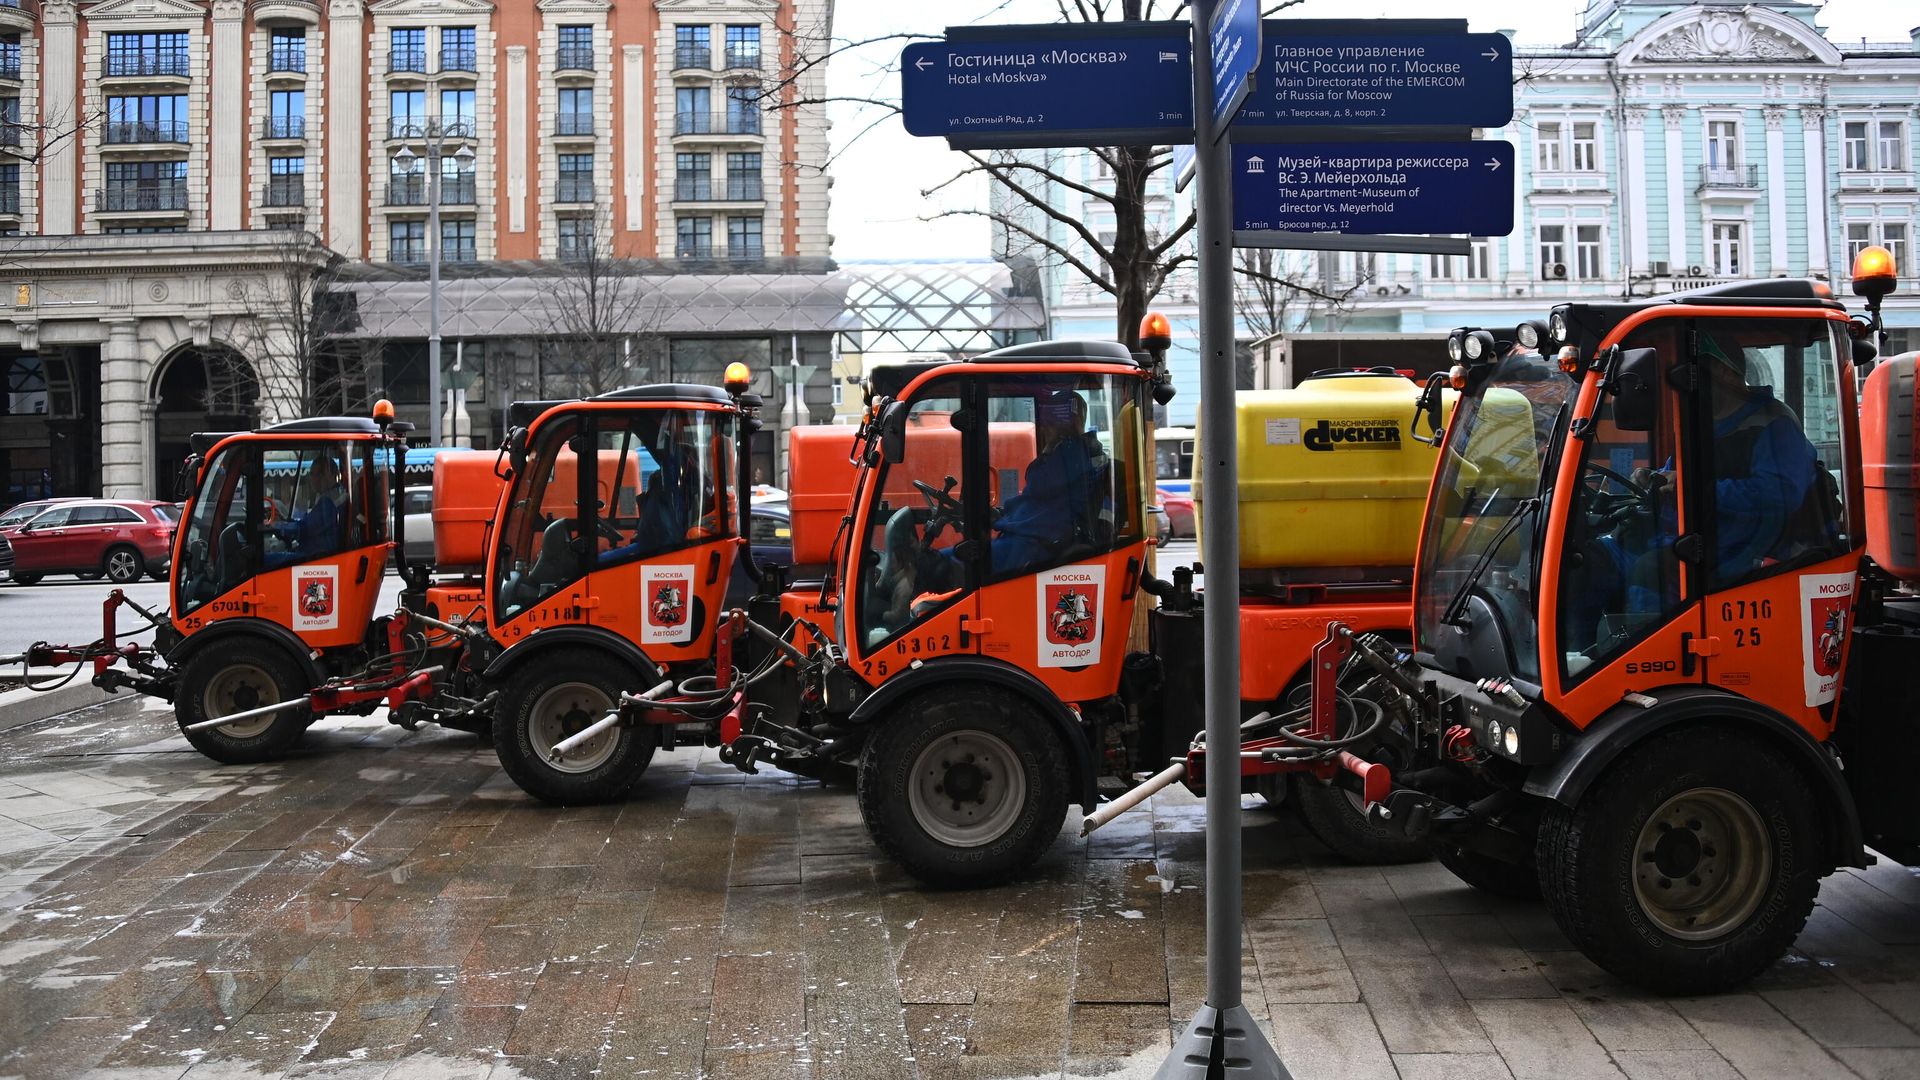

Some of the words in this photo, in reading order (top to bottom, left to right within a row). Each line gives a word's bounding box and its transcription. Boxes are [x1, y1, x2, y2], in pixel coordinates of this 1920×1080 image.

[948, 52, 1036, 68] Гостиница
[1041, 49, 1128, 64] «Москва»
[1275, 45, 1333, 58] Главное
[1338, 48, 1425, 60] управление
[1276, 61, 1310, 73] МЧС
[1314, 61, 1364, 73] России
[1369, 64, 1387, 73] по
[1392, 64, 1400, 73] г.
[1406, 60, 1461, 73] Москве
[948, 72, 981, 84] Hotal
[984, 72, 1047, 84] «Moskva»
[1276, 77, 1303, 87] Main
[1307, 76, 1368, 87] Directorate
[1371, 76, 1384, 87] of
[1385, 76, 1404, 87] the
[1406, 77, 1465, 86] EMERCOM
[1276, 90, 1288, 100] of
[1290, 90, 1324, 100] Russia
[1328, 90, 1344, 100] for
[1346, 90, 1392, 100] Moscow
[949, 118, 961, 126] ул.
[964, 114, 1003, 124] Охотный
[1006, 114, 1025, 125] Ряд,
[1027, 116, 1036, 124] д.
[1038, 114, 1044, 122] 2
[1159, 112, 1164, 120] 3
[1166, 112, 1182, 120] min
[1242, 110, 1246, 118] 7
[1248, 110, 1264, 118] min
[1276, 110, 1288, 119] ул.
[1291, 109, 1332, 118] Тверская,
[1334, 110, 1344, 118] д.
[1345, 109, 1352, 118] 8,
[1355, 110, 1378, 119] корп.
[1278, 156, 1392, 170] Музей-квартира
[1396, 158, 1470, 170] режиссера
[1278, 172, 1298, 184] Вс.
[1300, 172, 1311, 184] Э.
[1314, 172, 1406, 186] Мейерхольда
[1278, 188, 1298, 198] The
[1300, 188, 1406, 200] Apartment-Museum
[1409, 187, 1420, 197] of
[1280, 203, 1321, 213] director
[1324, 204, 1338, 212] Vs.
[1340, 202, 1394, 214] Meyerhold
[1252, 220, 1269, 228] min
[1278, 220, 1310, 230] Брюсов
[1331, 222, 1339, 230] д.
[1340, 220, 1350, 228] 12
[1054, 574, 1092, 582] МОСКВА
[448, 594, 485, 602] HOLD
[212, 602, 240, 612] 6701
[1722, 600, 1772, 622] 6716
[185, 618, 200, 628] 25
[1734, 627, 1760, 648] 25
[897, 634, 950, 654] 6362
[1052, 650, 1090, 658] АВТОДОР
[864, 661, 888, 676] 25
[1626, 663, 1638, 674] S
[1641, 660, 1676, 672] 990
